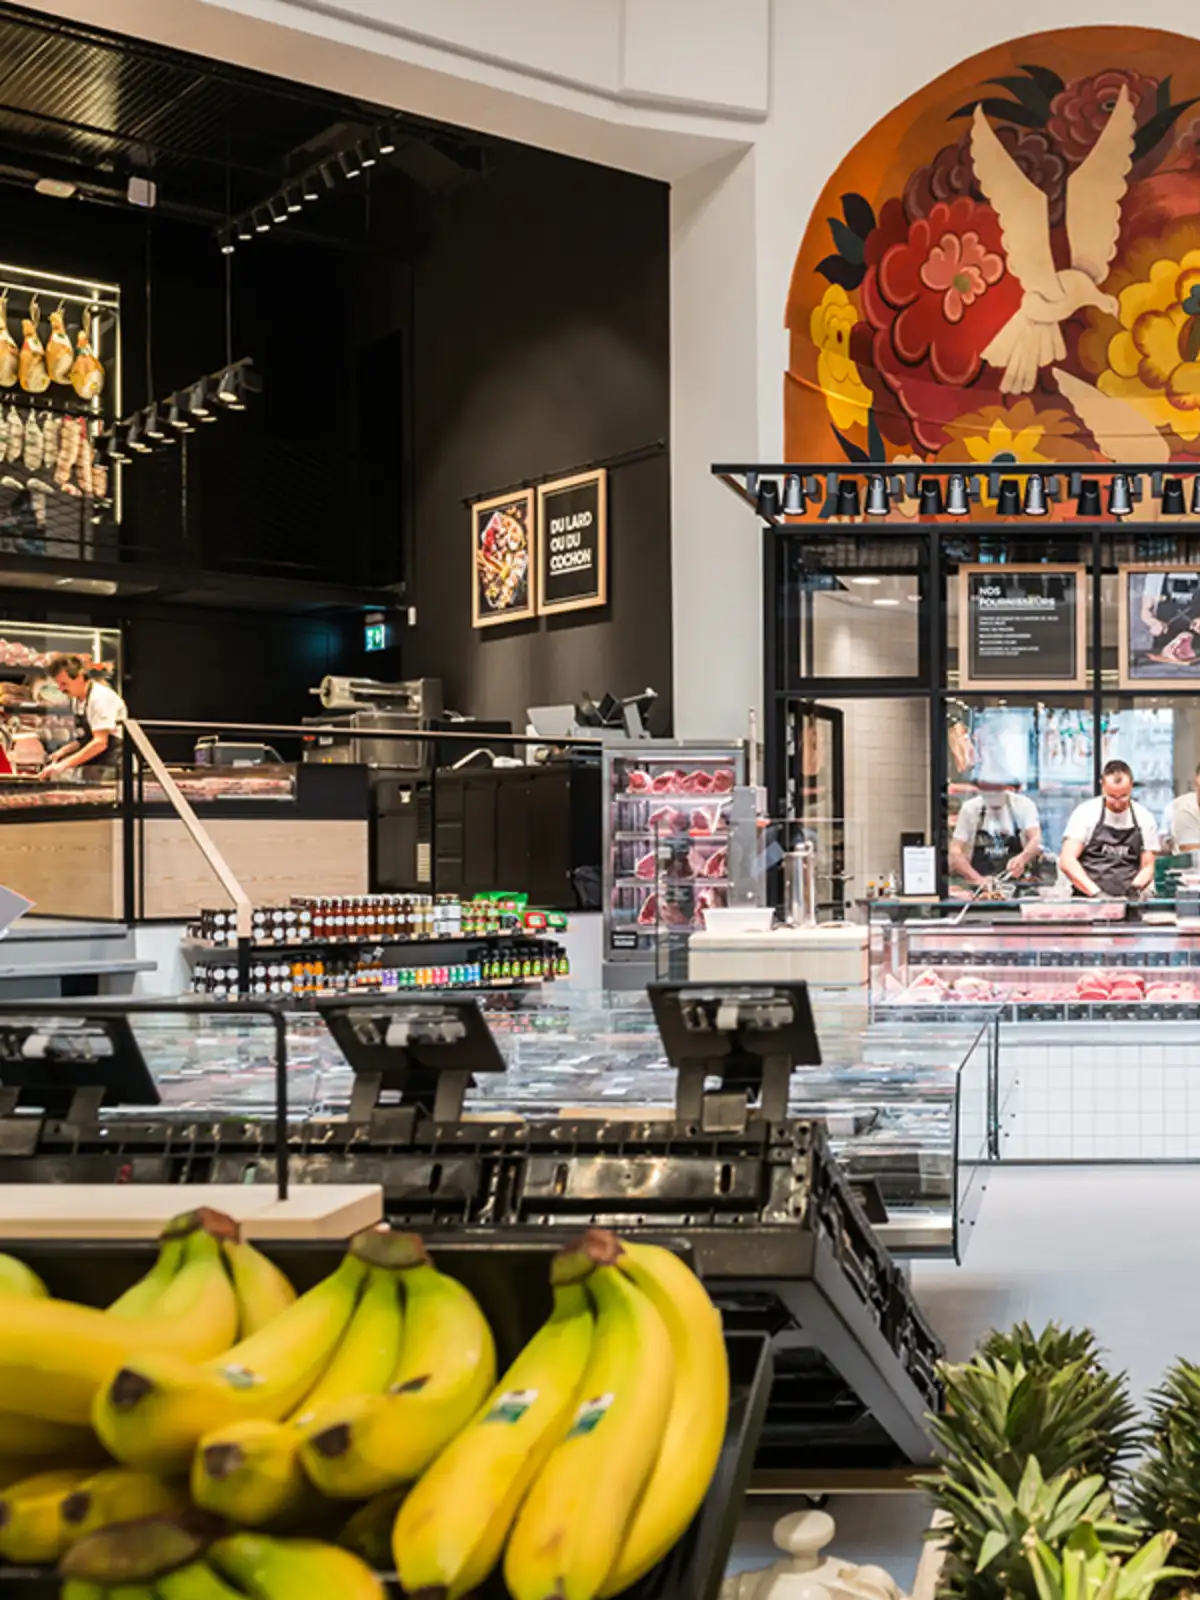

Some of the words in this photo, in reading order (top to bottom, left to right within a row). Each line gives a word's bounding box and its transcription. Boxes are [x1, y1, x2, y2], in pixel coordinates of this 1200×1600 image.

[550, 518, 565, 534] DU
[566, 511, 592, 531] LARD
[550, 537, 565, 552] OU
[566, 532, 581, 548] DU
[550, 548, 591, 570] COCHON
